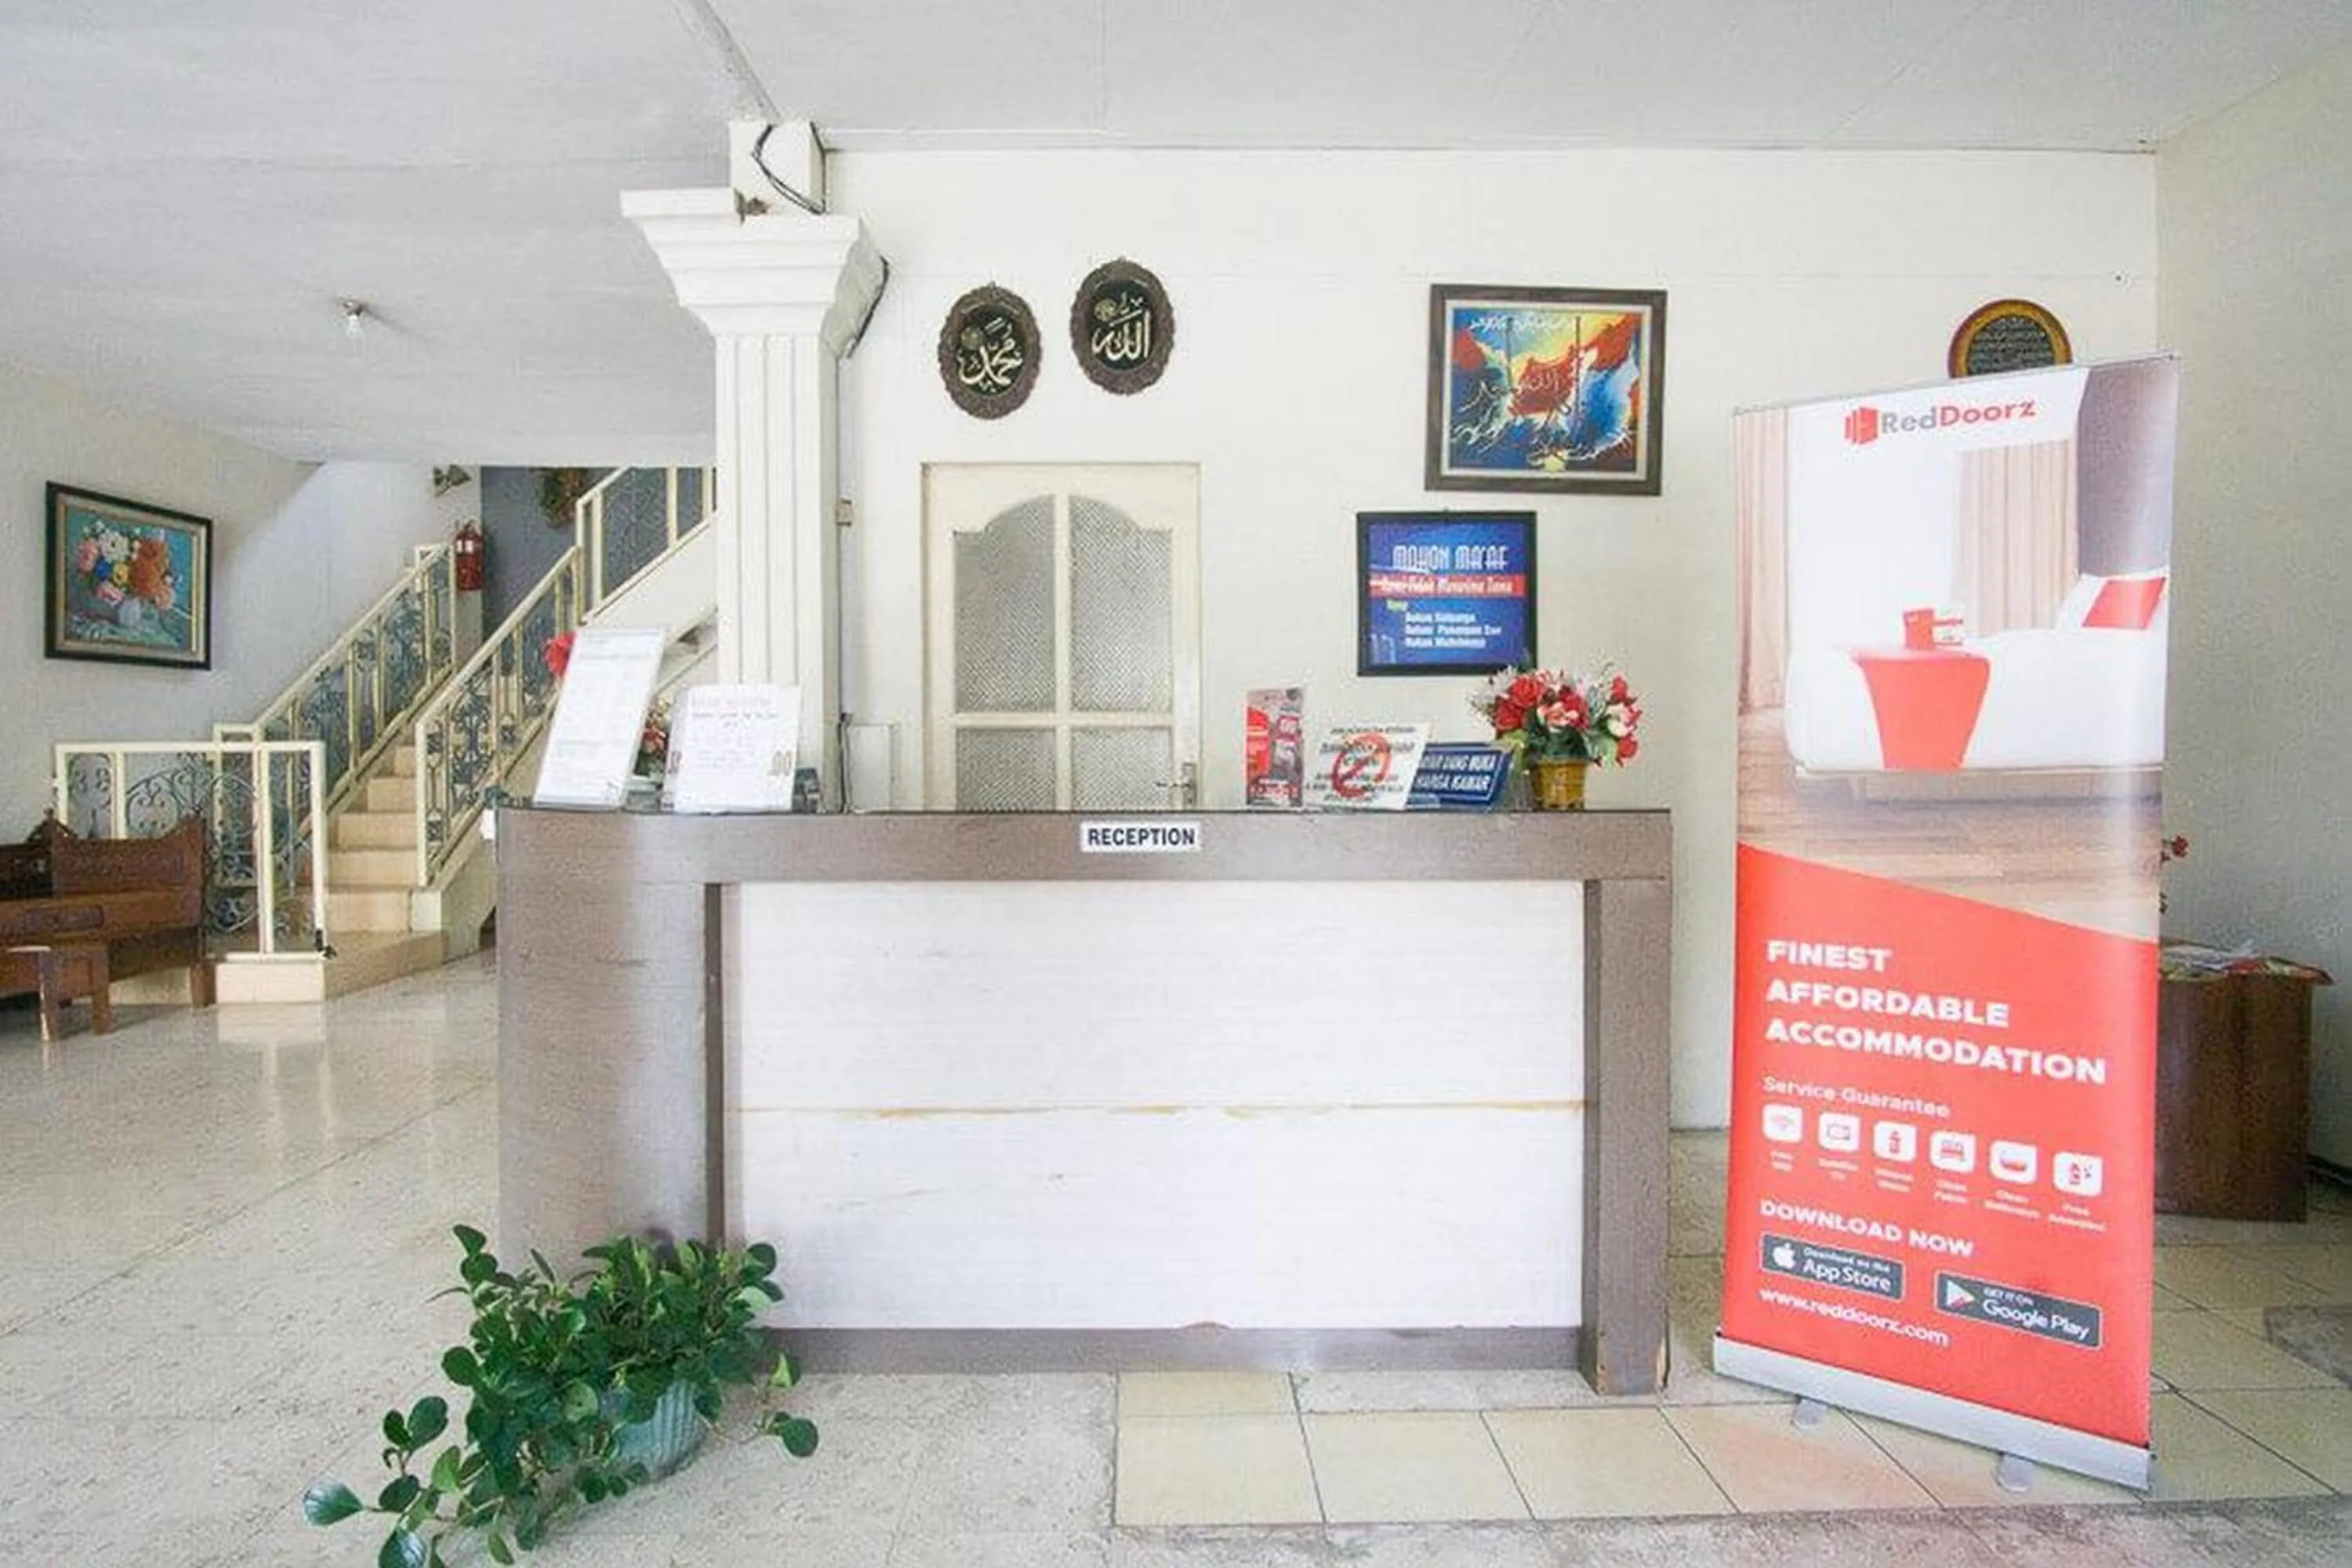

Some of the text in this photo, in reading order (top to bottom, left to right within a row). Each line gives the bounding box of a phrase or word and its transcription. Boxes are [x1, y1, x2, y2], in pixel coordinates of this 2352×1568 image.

[1882, 398, 2036, 435] RedDoorz
[1087, 827, 1196, 846] RECEPTION
[1766, 941, 1892, 971] FINEST
[1766, 978, 2010, 1028] AFFORDABLE
[1764, 1018, 2107, 1085] ACCOMMODATION
[1762, 1076, 1951, 1119] Service Guarantee
[1759, 1198, 1975, 1258] DOWNLOAD NOW
[1803, 1258, 1892, 1293] App Store
[1759, 1289, 1948, 1348] www.reddoorz.com
[1982, 1298, 2090, 1341] Google Play
